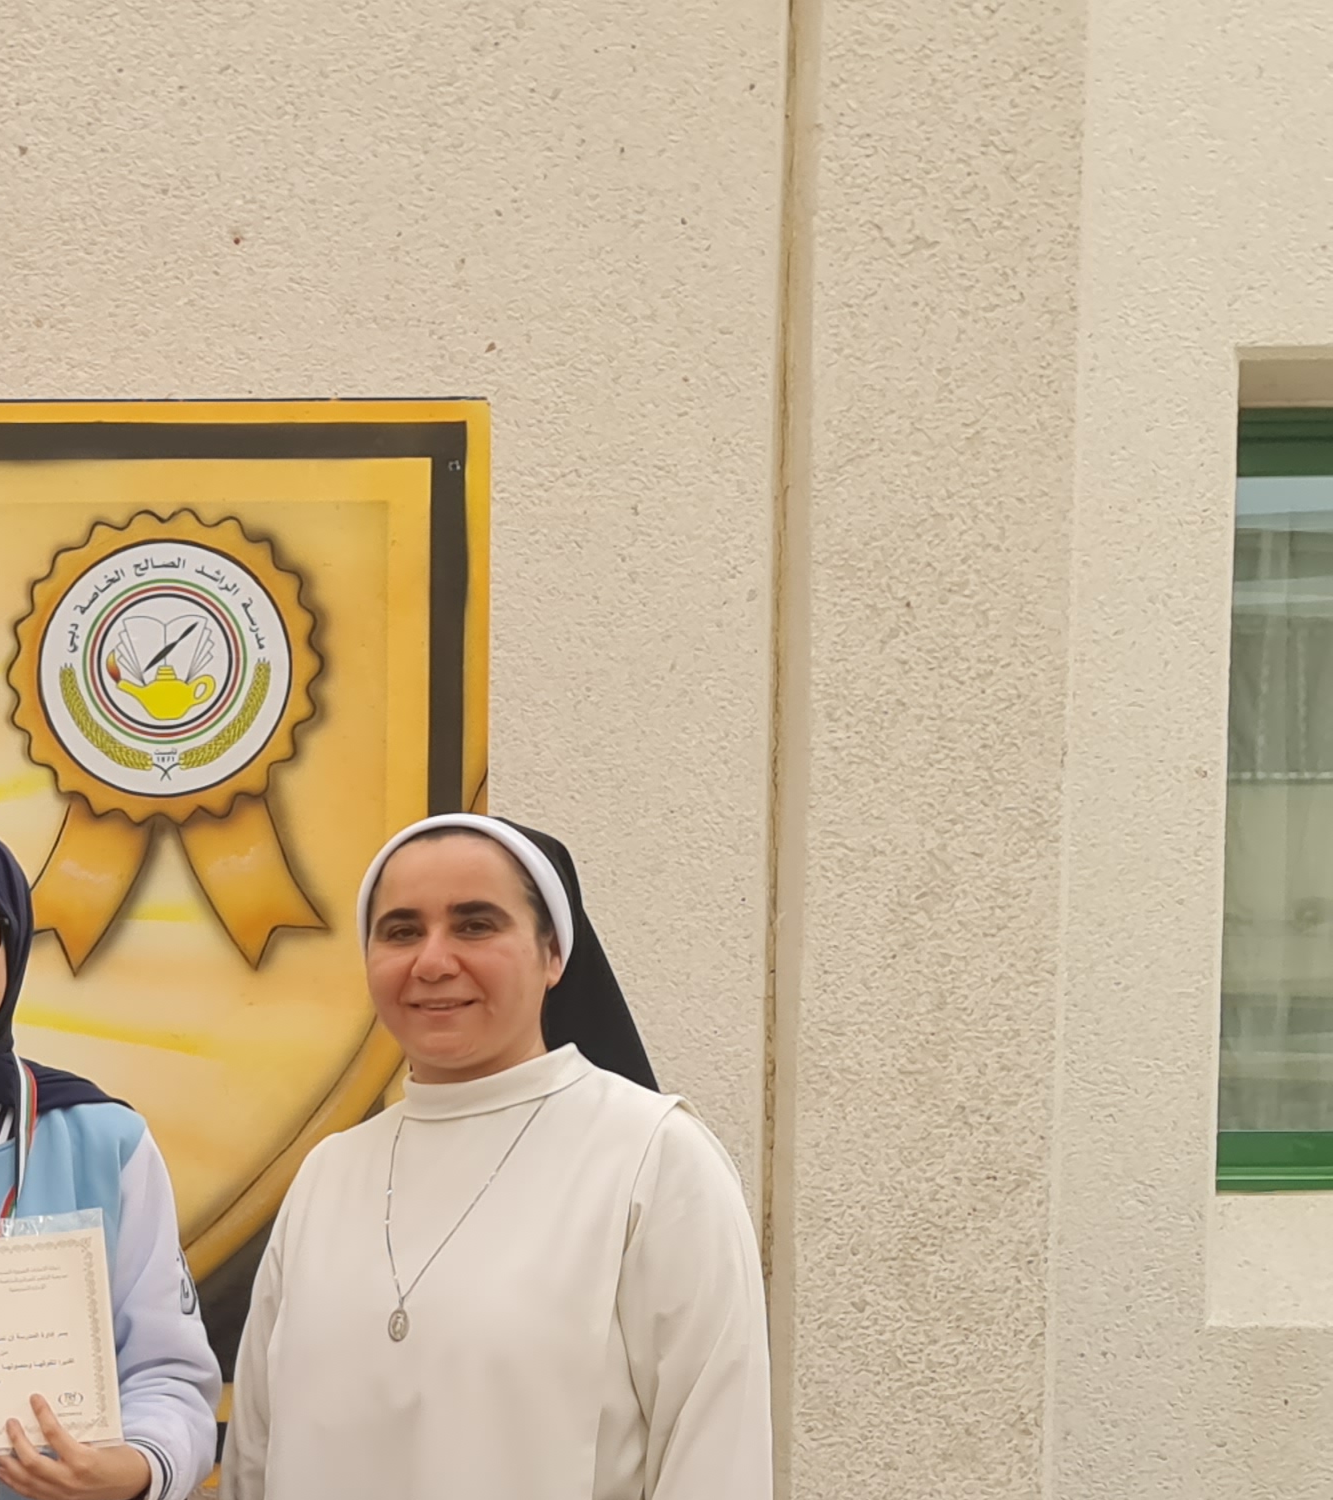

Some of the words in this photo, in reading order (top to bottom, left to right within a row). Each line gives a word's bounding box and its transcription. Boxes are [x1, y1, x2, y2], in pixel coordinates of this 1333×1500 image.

[133, 557, 186, 577] الصالح
[194, 565, 240, 596] الراشد
[66, 623, 79, 653] دبي
